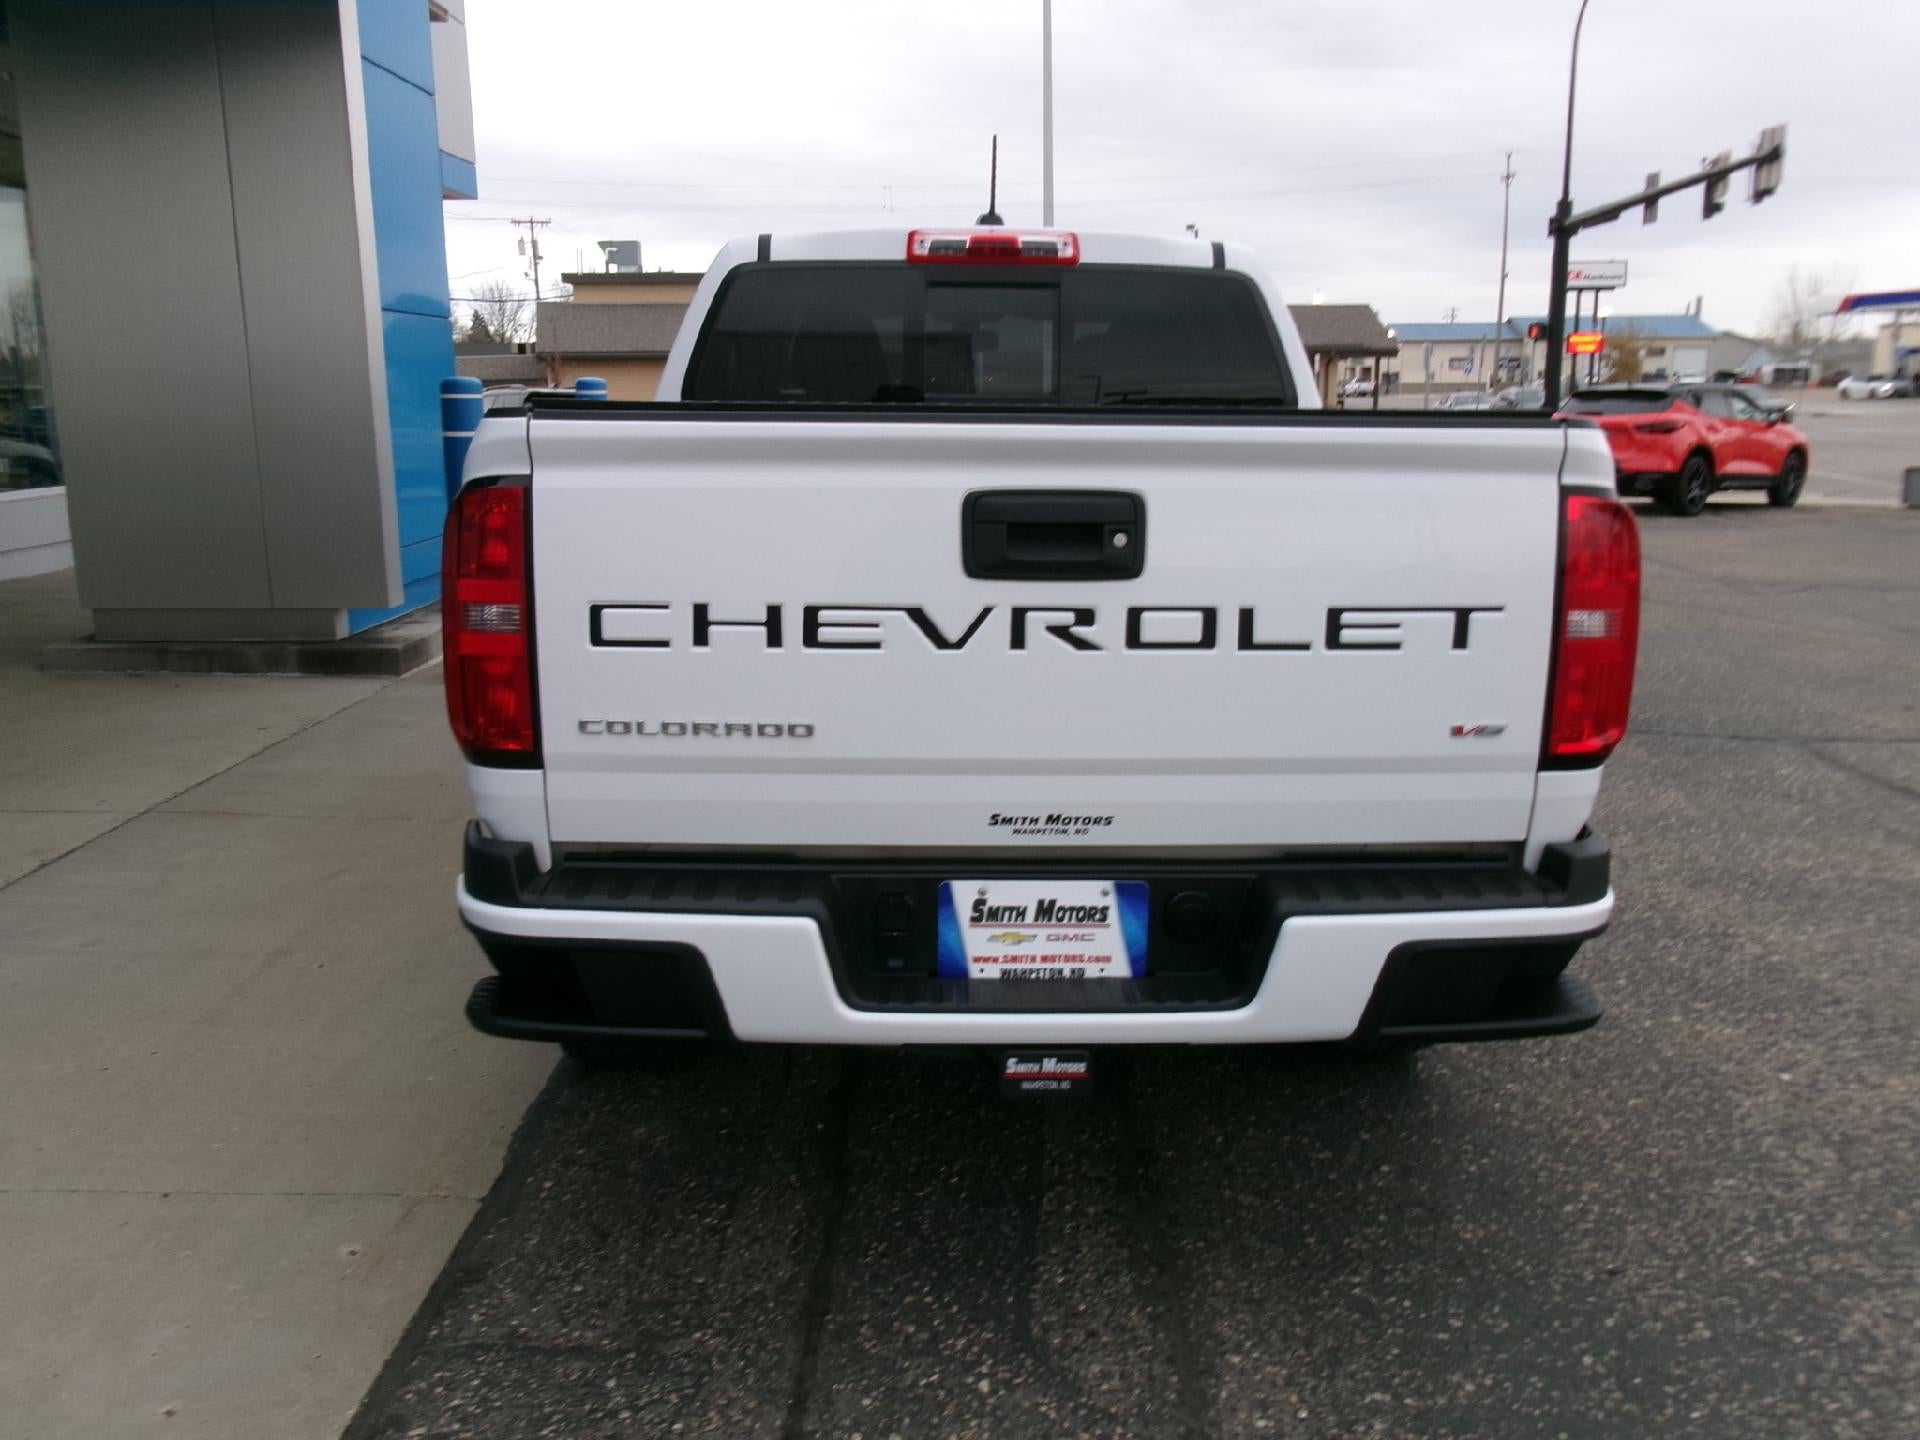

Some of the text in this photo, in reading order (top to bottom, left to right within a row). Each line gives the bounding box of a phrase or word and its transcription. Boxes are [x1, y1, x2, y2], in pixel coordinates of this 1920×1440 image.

[589, 602, 1505, 652] CHEVROLET
[578, 719, 815, 738] COLORADO
[988, 813, 1115, 826] SMITH MOTORS
[970, 898, 1110, 923] SMITH MOTORS
[1045, 933, 1096, 942] GMC
